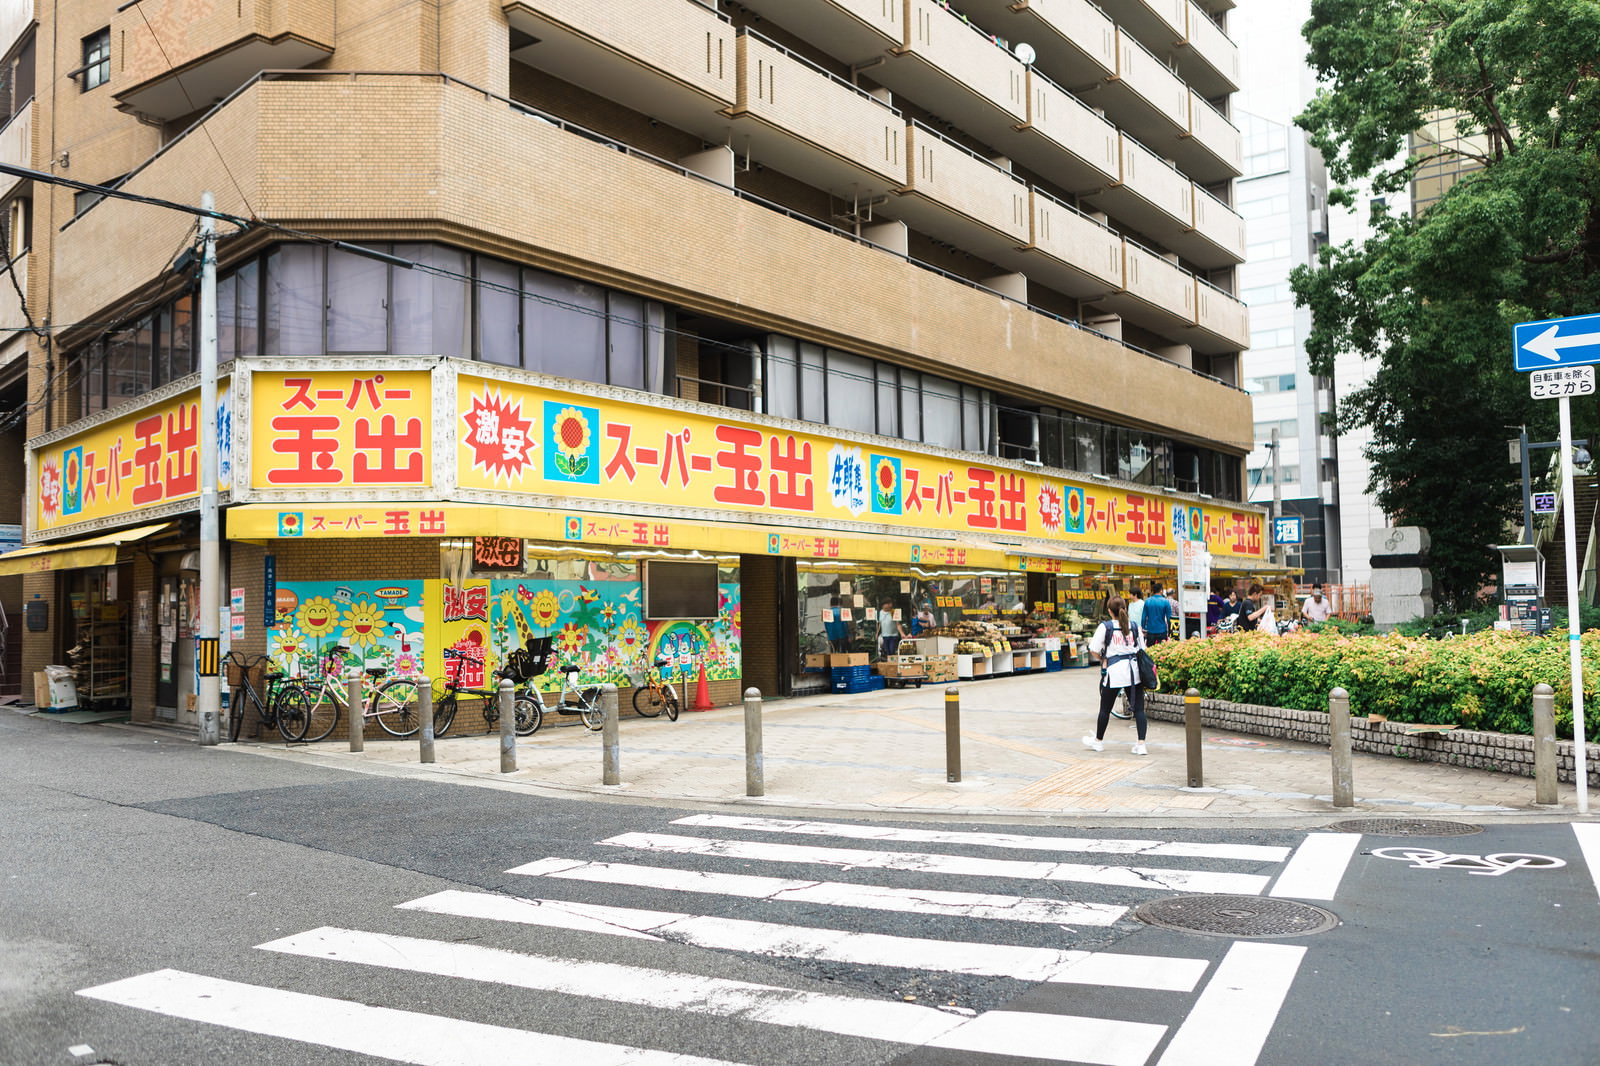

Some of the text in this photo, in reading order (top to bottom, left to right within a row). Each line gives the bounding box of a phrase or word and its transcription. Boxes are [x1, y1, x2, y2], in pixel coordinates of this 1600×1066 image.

[1533, 370, 1591, 383] 自転車を除く
[1533, 380, 1592, 397] ここから
[282, 374, 411, 411] スーパー
[267, 414, 423, 484] 玉出
[475, 409, 525, 460] 激安
[83, 403, 198, 506] スーパー玉出
[604, 424, 815, 512] スーパー玉出
[904, 467, 1027, 532] スーパー玉出
[1535, 495, 1555, 512] 空
[311, 510, 445, 535] スーパー玉出
[587, 522, 669, 546] スーパー玉出
[1086, 494, 1166, 546] スーパー玉出
[1203, 512, 1261, 555] スーパー玉出
[1276, 519, 1299, 542] 酒
[782, 537, 839, 557] スーパー玉出
[922, 547, 966, 565] スーパー玉出
